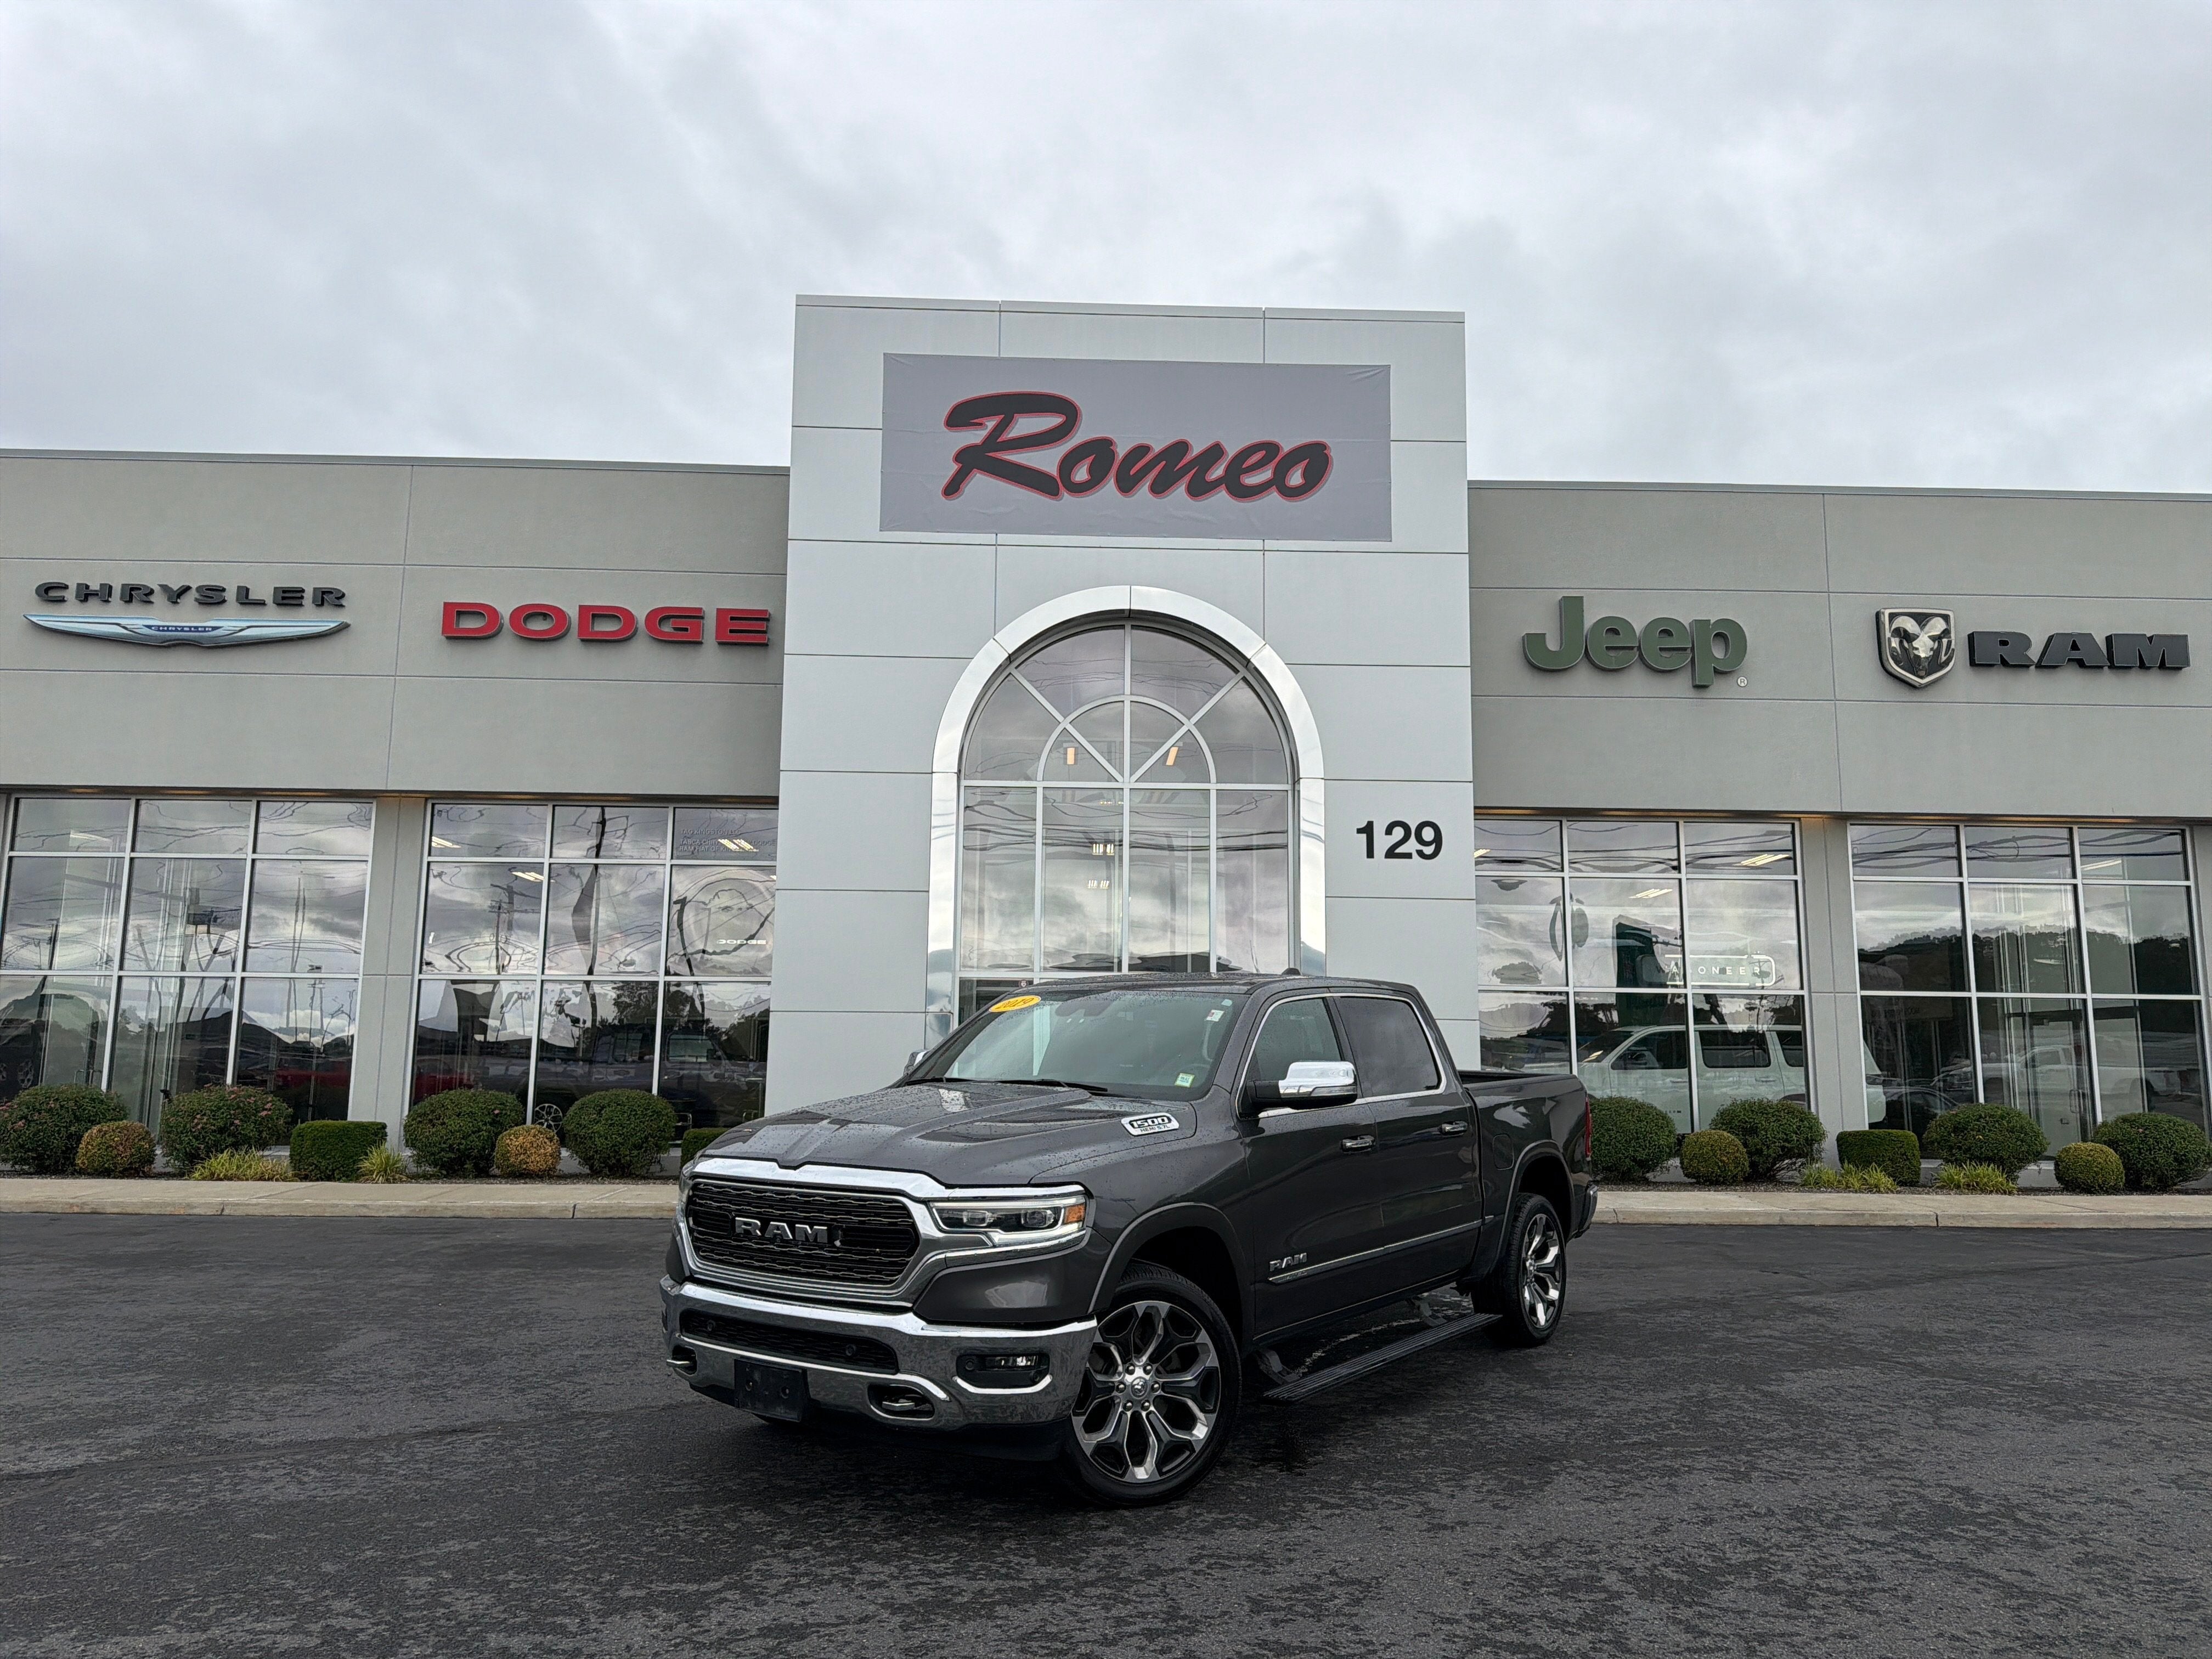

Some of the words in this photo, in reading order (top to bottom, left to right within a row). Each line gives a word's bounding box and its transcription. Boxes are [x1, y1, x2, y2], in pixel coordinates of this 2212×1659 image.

[941, 391, 1332, 502] Romeo
[34, 582, 347, 607] CHRYSLER
[442, 601, 771, 646] DODGE
[1522, 596, 1747, 688] Jeep
[1967, 631, 2191, 669] RAM
[1356, 820, 1443, 860] 129
[994, 997, 1036, 1010] 2019
[1130, 1116, 1169, 1128] 1500
[735, 1217, 827, 1244] RAM
[1269, 1252, 1307, 1272] RAM
